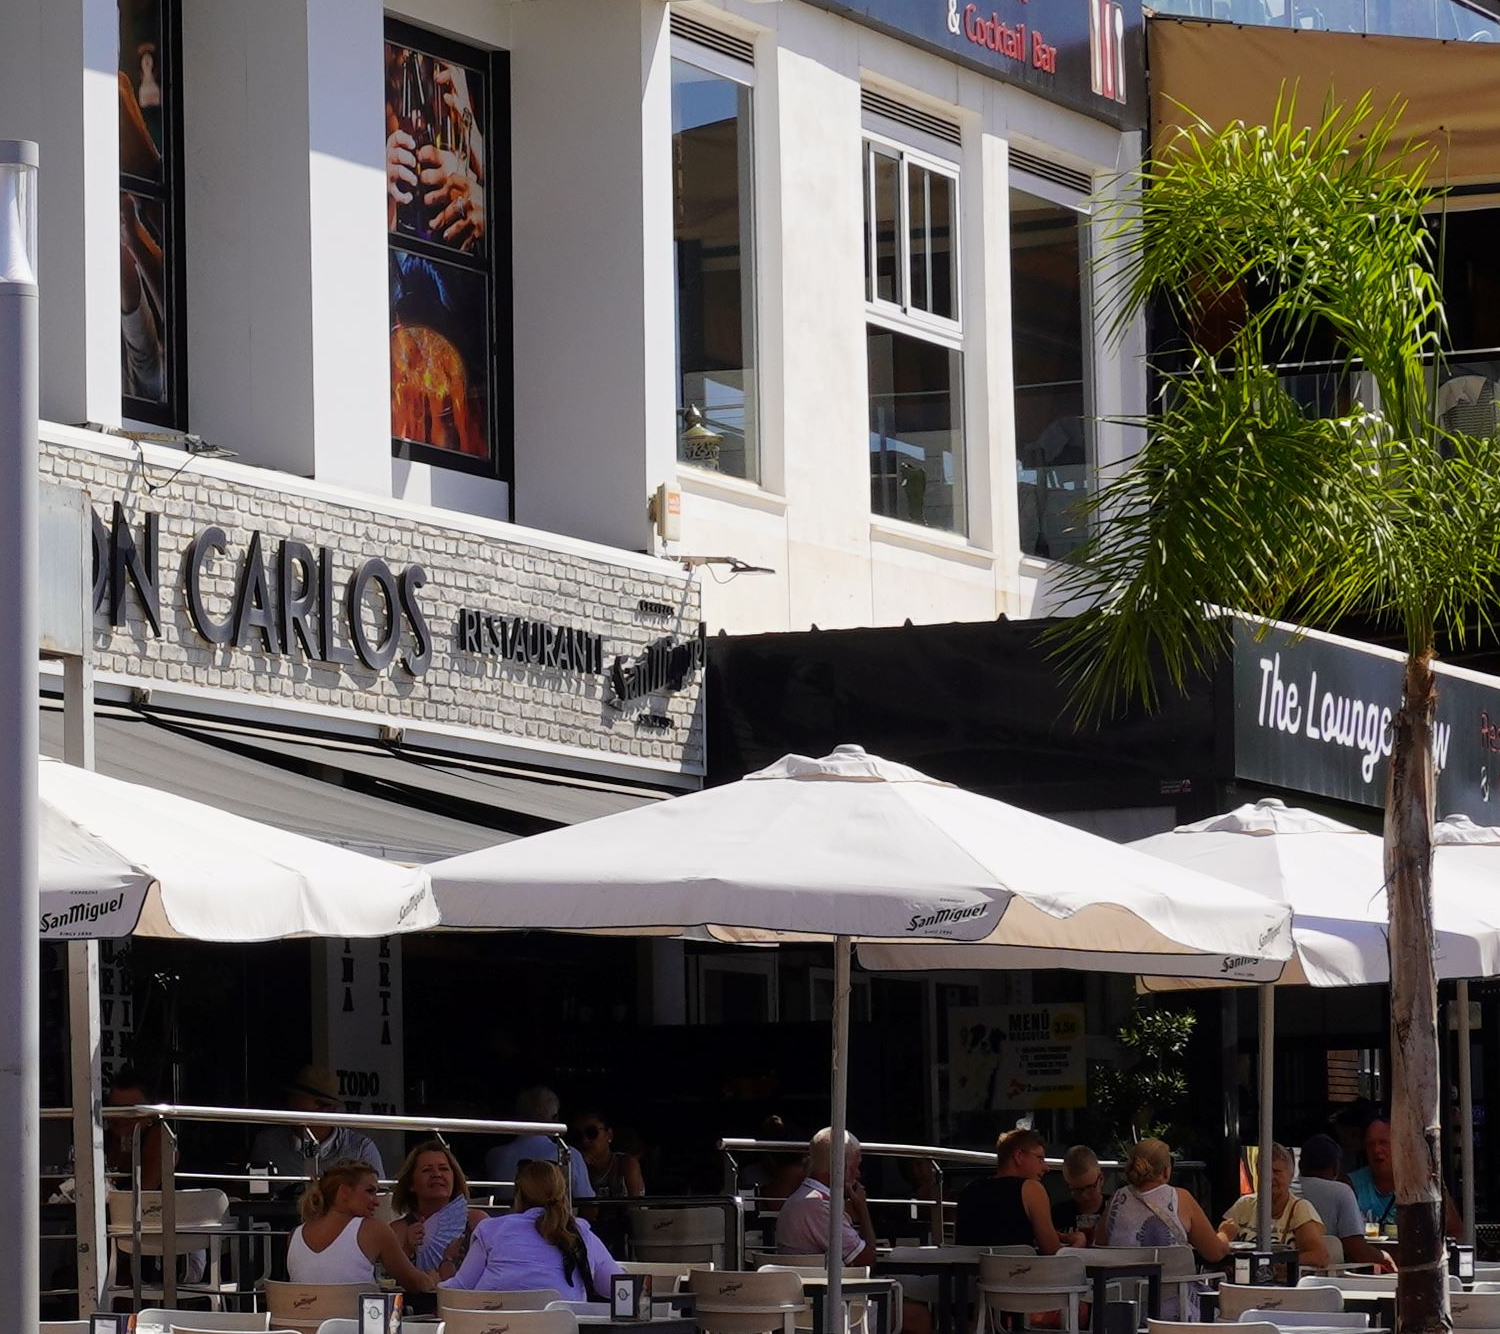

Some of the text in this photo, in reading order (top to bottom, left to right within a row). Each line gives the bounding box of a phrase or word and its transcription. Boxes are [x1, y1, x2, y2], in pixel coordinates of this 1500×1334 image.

[963, 2, 1027, 62] Cocktail
[1031, 29, 1058, 74] Bar
[186, 527, 433, 677] CARLOS
[459, 608, 602, 675] RESTAURANT
[1258, 651, 1302, 736] The
[1306, 670, 1393, 785] Lounge
[1008, 1008, 1050, 1032] MENÚ
[337, 1069, 380, 1097] TODO
